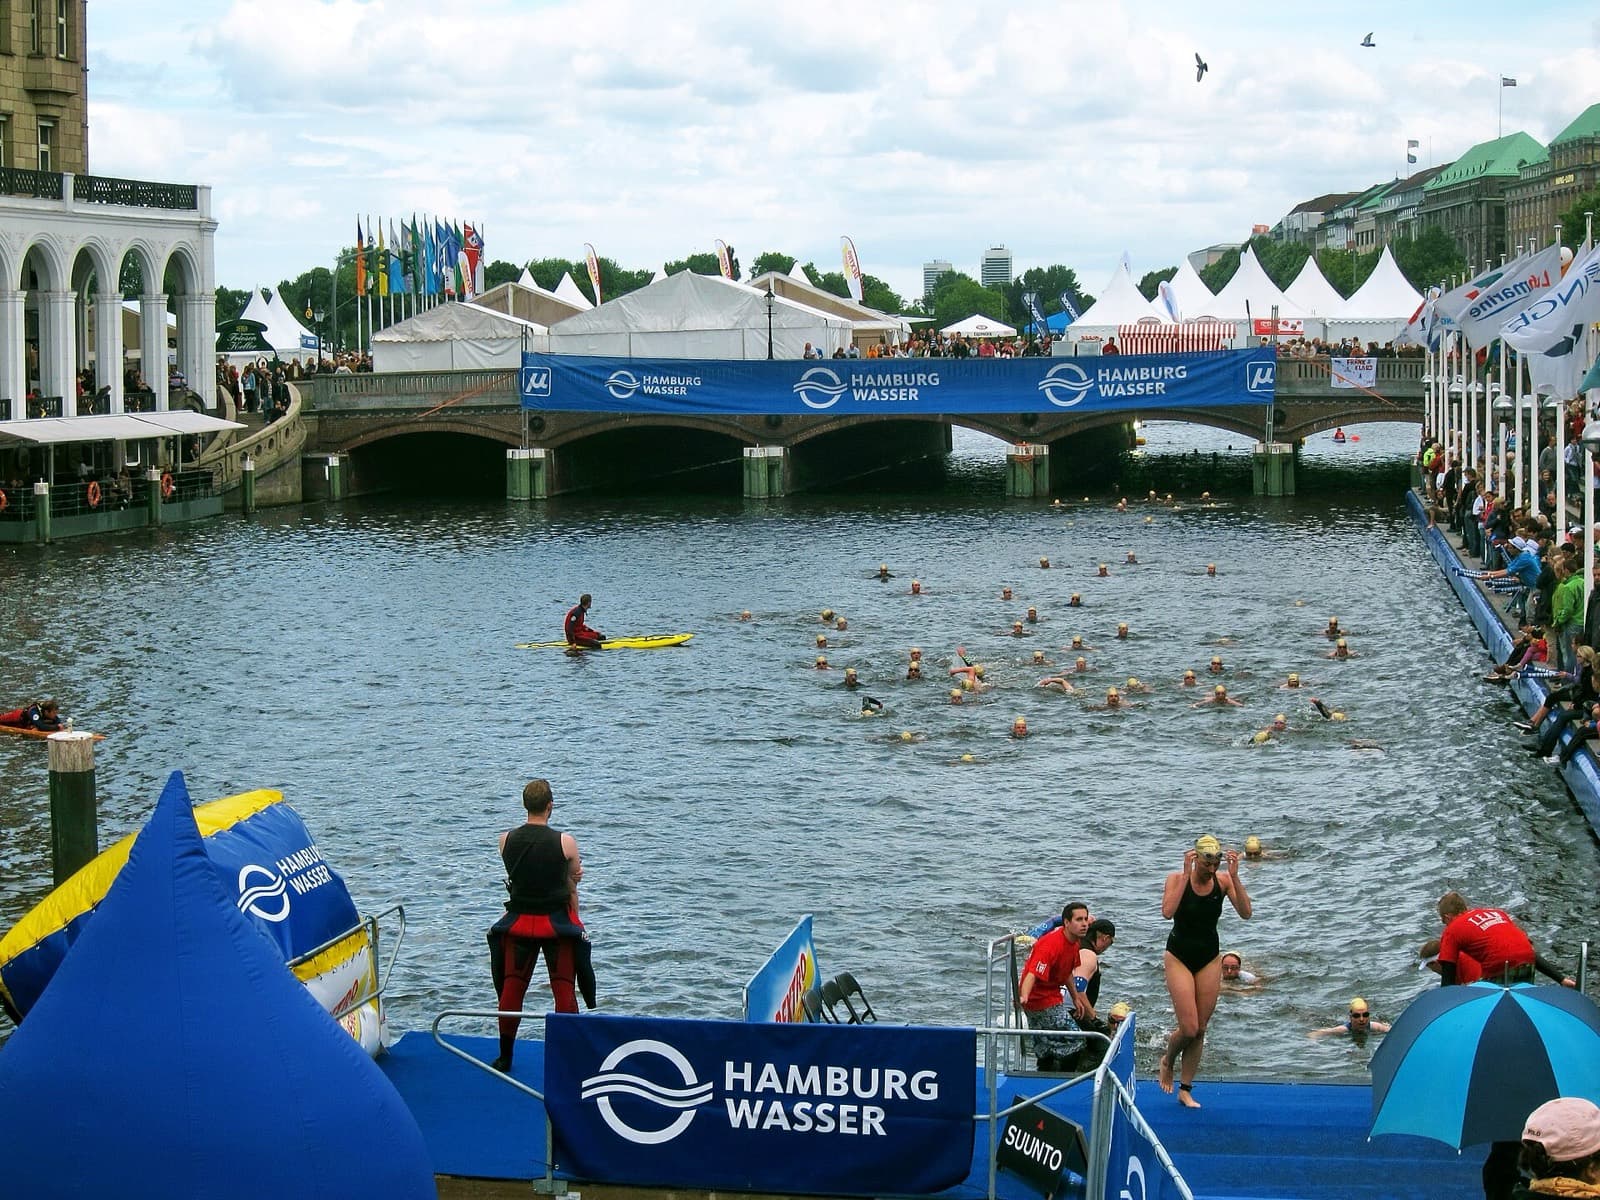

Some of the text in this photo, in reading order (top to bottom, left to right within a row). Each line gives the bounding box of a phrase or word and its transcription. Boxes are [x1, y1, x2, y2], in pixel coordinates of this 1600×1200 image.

[642, 374, 702, 388] HAMBURG
[851, 371, 941, 388] HAMBURG
[1097, 365, 1188, 382] HAMBURG
[642, 384, 688, 396] WASSER
[852, 387, 920, 402] WASSER
[1098, 382, 1166, 398] WASSER
[288, 865, 333, 896] WASSER
[724, 1060, 939, 1101] HAMBURG
[725, 1098, 888, 1137] WASSER
[1004, 1124, 1063, 1171] SUUNTO
